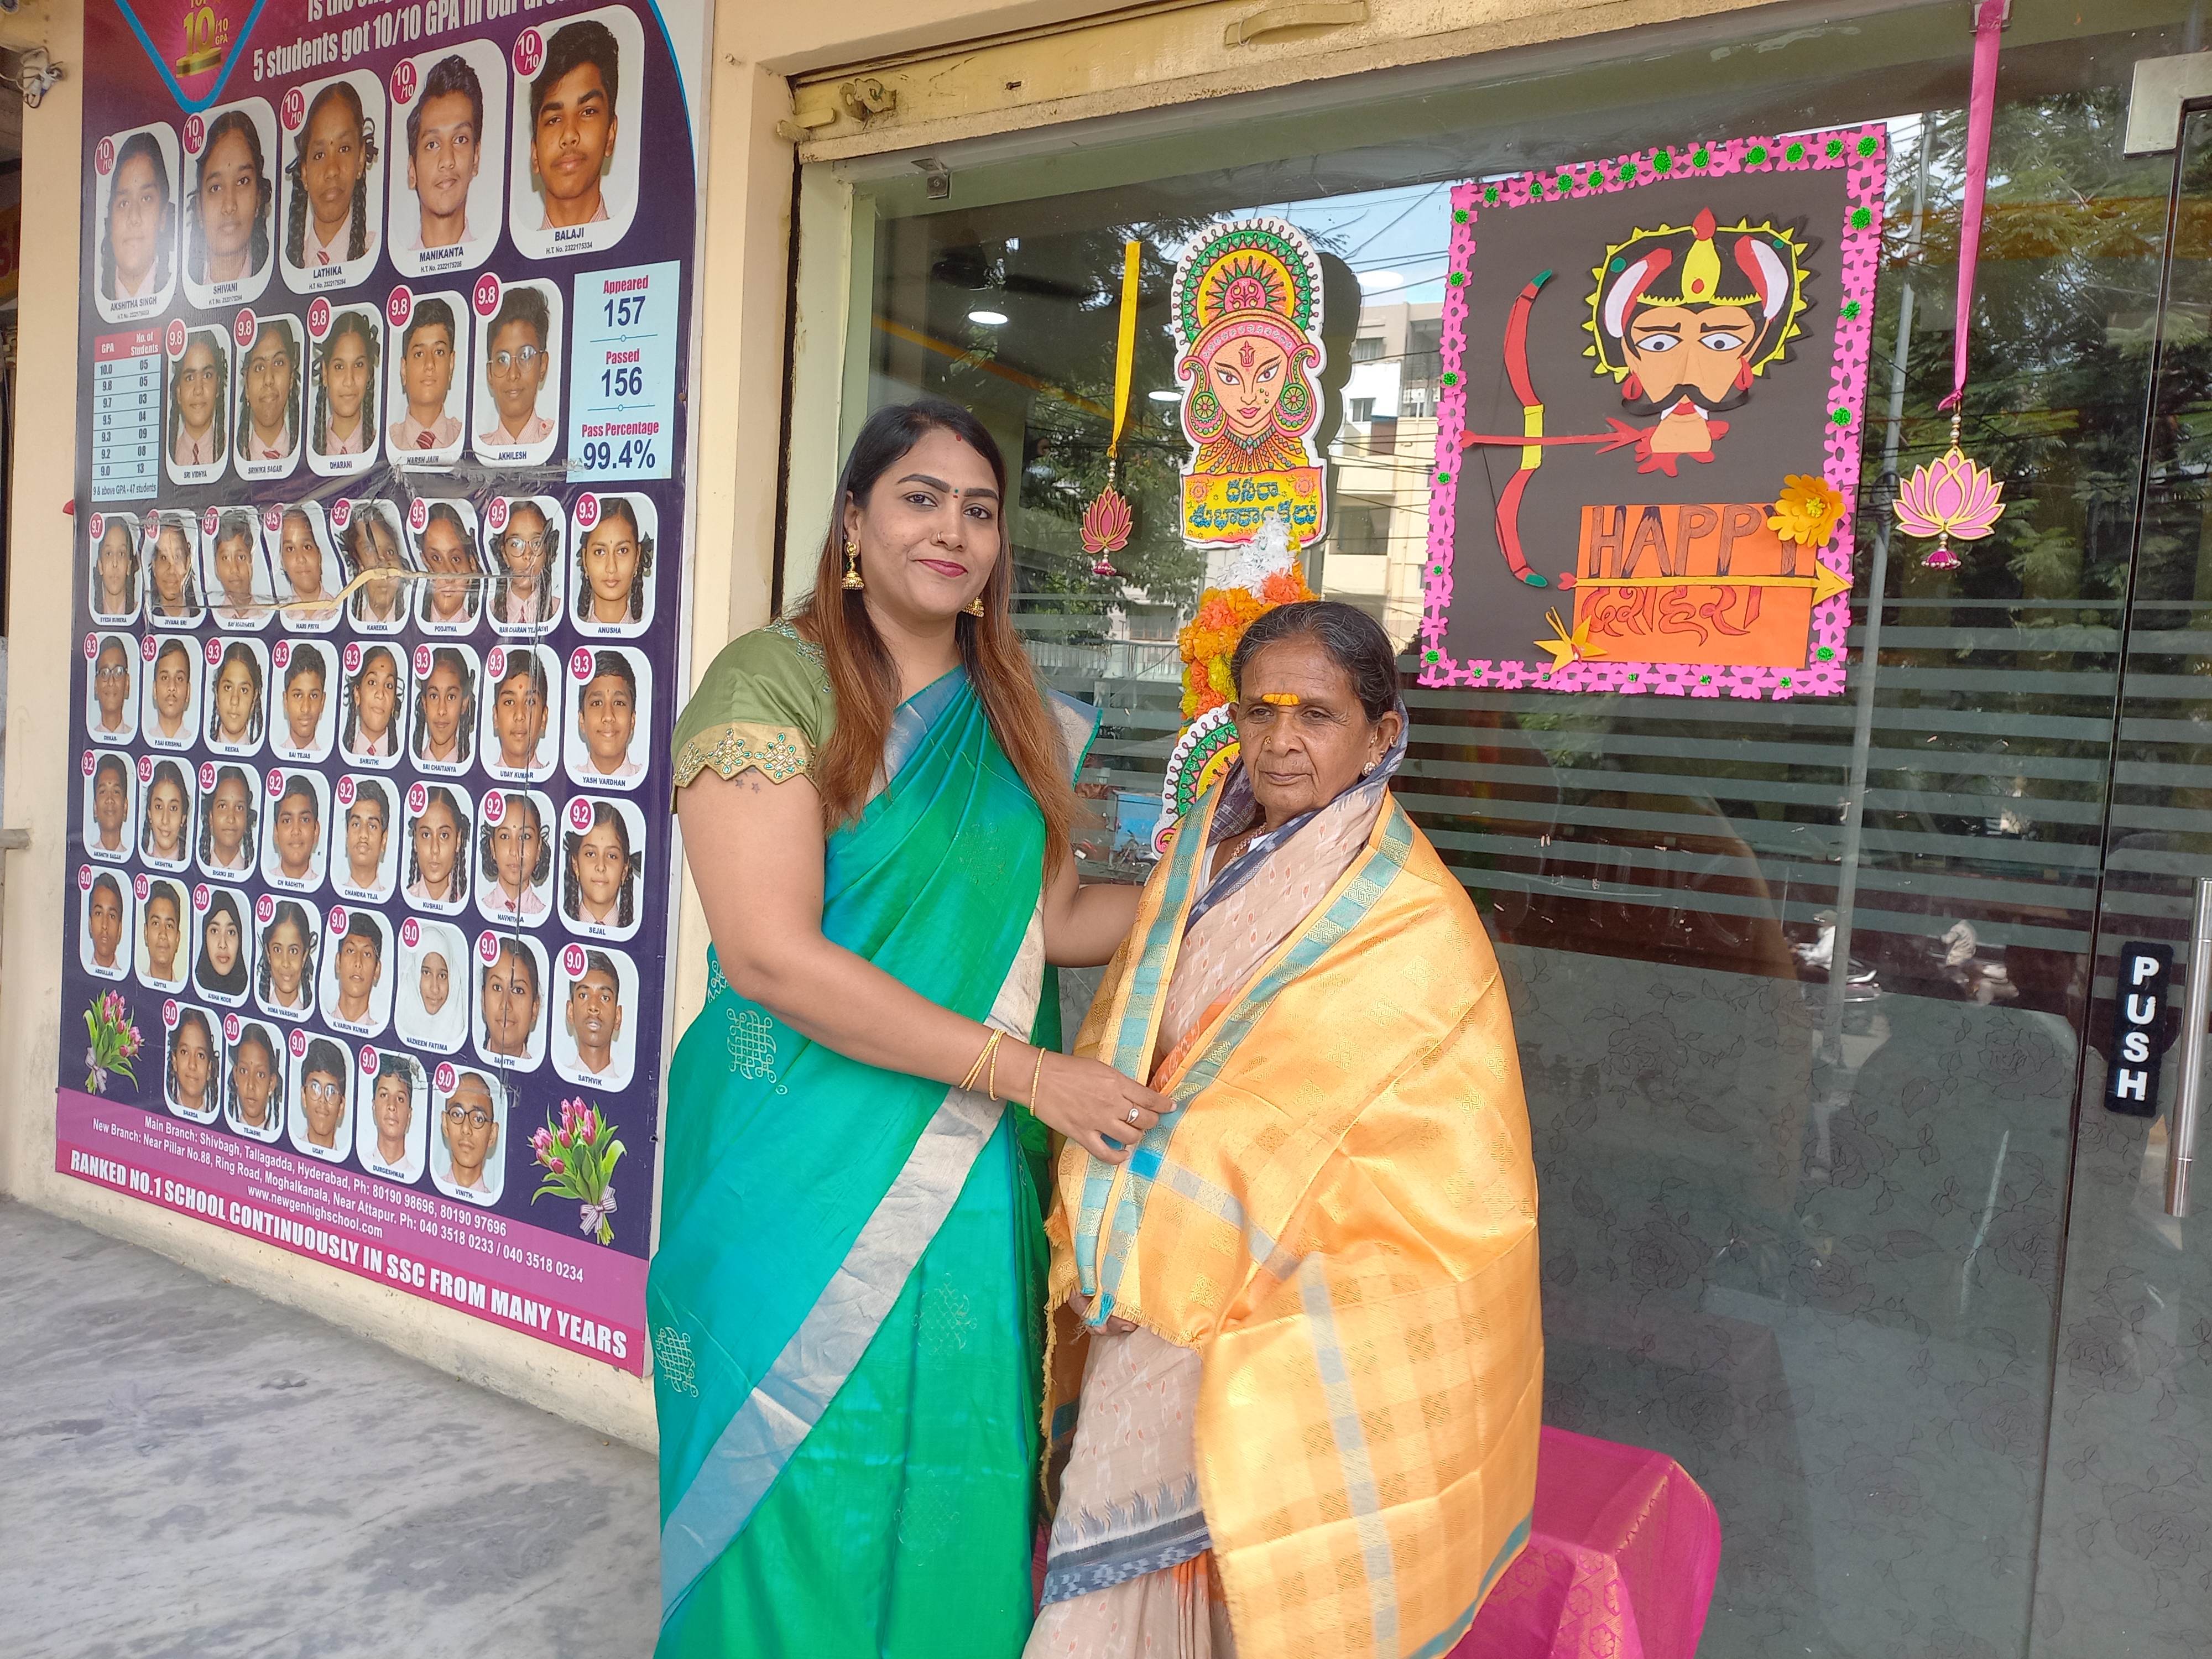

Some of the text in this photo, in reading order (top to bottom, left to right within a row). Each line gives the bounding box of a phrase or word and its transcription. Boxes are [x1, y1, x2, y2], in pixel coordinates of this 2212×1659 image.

[184, 7, 215, 58] 10
[215, 18, 228, 33] /10
[215, 33, 228, 45] GPA
[253, 49, 263, 82] 5
[267, 32, 337, 79] students
[342, 20, 369, 62] got
[373, 4, 422, 50] 10/10
[425, 0, 460, 36] GPA
[518, 34, 535, 56] 10
[524, 54, 539, 70] /10
[395, 65, 410, 84] 10
[401, 84, 414, 99] /10
[285, 93, 299, 112] 10
[290, 111, 301, 125] /10
[187, 119, 199, 136] 10
[191, 137, 202, 149] /10
[98, 143, 109, 159] 10
[103, 159, 111, 170] /10
[555, 227, 584, 241] BALAJI
[420, 247, 463, 262] MANIKANTA
[314, 266, 342, 279] LATHIKA
[213, 283, 238, 295] SHIVANI
[603, 275, 649, 294] Appeared
[478, 286, 495, 304] 9.8
[111, 296, 156, 311] AKSHITHA SINGH
[392, 299, 407, 315] 9.8
[604, 295, 646, 327] 157
[312, 310, 326, 326] 9.8
[238, 320, 251, 336] 9.8
[136, 331, 153, 343] No. of
[170, 331, 182, 346] 9.8
[102, 343, 114, 353] GPA
[131, 343, 158, 356] Students
[606, 348, 640, 364] Passed
[100, 359, 148, 375] 10.0 05
[102, 376, 148, 391] 9.8 05
[601, 367, 643, 397] 156
[103, 394, 147, 408] 9.7 03
[102, 411, 146, 425] 9.5 04
[102, 429, 147, 442] 9.3 09
[582, 421, 659, 437] Pass Percentage
[101, 446, 146, 459] 9.2 08
[426, 455, 439, 463] JAIN
[498, 451, 526, 460] AKHILESH
[583, 439, 655, 469] 99.4%
[101, 463, 144, 476] 9.0 13
[330, 461, 352, 469] DHARANI
[333, 507, 348, 520] 9.5
[413, 507, 424, 522] 9.5
[492, 505, 504, 521] 9.5
[580, 502, 594, 519] 9.3
[92, 520, 101, 533] 9.7
[87, 639, 96, 653] 9.3
[144, 640, 154, 656] 9.3
[208, 645, 219, 659] 9.3
[275, 648, 286, 662] 9.3
[346, 650, 358, 665] 9.3
[417, 653, 428, 667] 9.3
[490, 654, 502, 670] 9.3
[574, 656, 588, 672] 9.3
[84, 757, 93, 770] 9.2
[140, 763, 150, 776] 9.2
[202, 769, 212, 783] 9.2
[269, 776, 281, 790] 9.2
[598, 778, 625, 786] VARDHAN
[340, 783, 352, 798] 9.2
[411, 790, 423, 806] 9.2
[487, 798, 500, 815] 9.2
[573, 805, 588, 823] 9.2
[81, 871, 90, 885] 9.0
[137, 880, 146, 894] 9.0
[196, 890, 207, 905] 9.0
[259, 901, 271, 916] 9.0
[332, 912, 344, 928] 9.0
[405, 925, 416, 941] 9.0
[589, 927, 606, 936] SEJAL
[482, 938, 494, 955] 9.0
[567, 951, 581, 969] 9.0
[166, 1005, 175, 1020] 9.0
[227, 1020, 237, 1035] 9.0
[2116, 956, 2159, 1102] PUSH
[292, 1036, 303, 1051] 9.0
[406, 1037, 447, 1051] NAZNEEN FATIMA
[363, 1052, 374, 1068] 9.0
[438, 1070, 452, 1087] 9.0
[578, 1074, 602, 1085] SATHVIK
[145, 1115, 507, 1237] Main Branch: Shivbagh, Tallagadda, Hyderabad, Ph: 80190 98696, 80190 97696
[373, 1165, 405, 1179] DURGESHWAR
[93, 1118, 583, 1283] New Branch: Near Pillar No.88, Ring Road, Moghalkanala, Near Attapur. Ph: 040 3518 0233 / 040 3518 0234
[247, 1185, 384, 1239] www.newgenhighschool.com
[71, 1149, 627, 1359] RANKED NO.1 SCHOOL CONTINUOUSLY IN SSC FROM MANY YEARS
